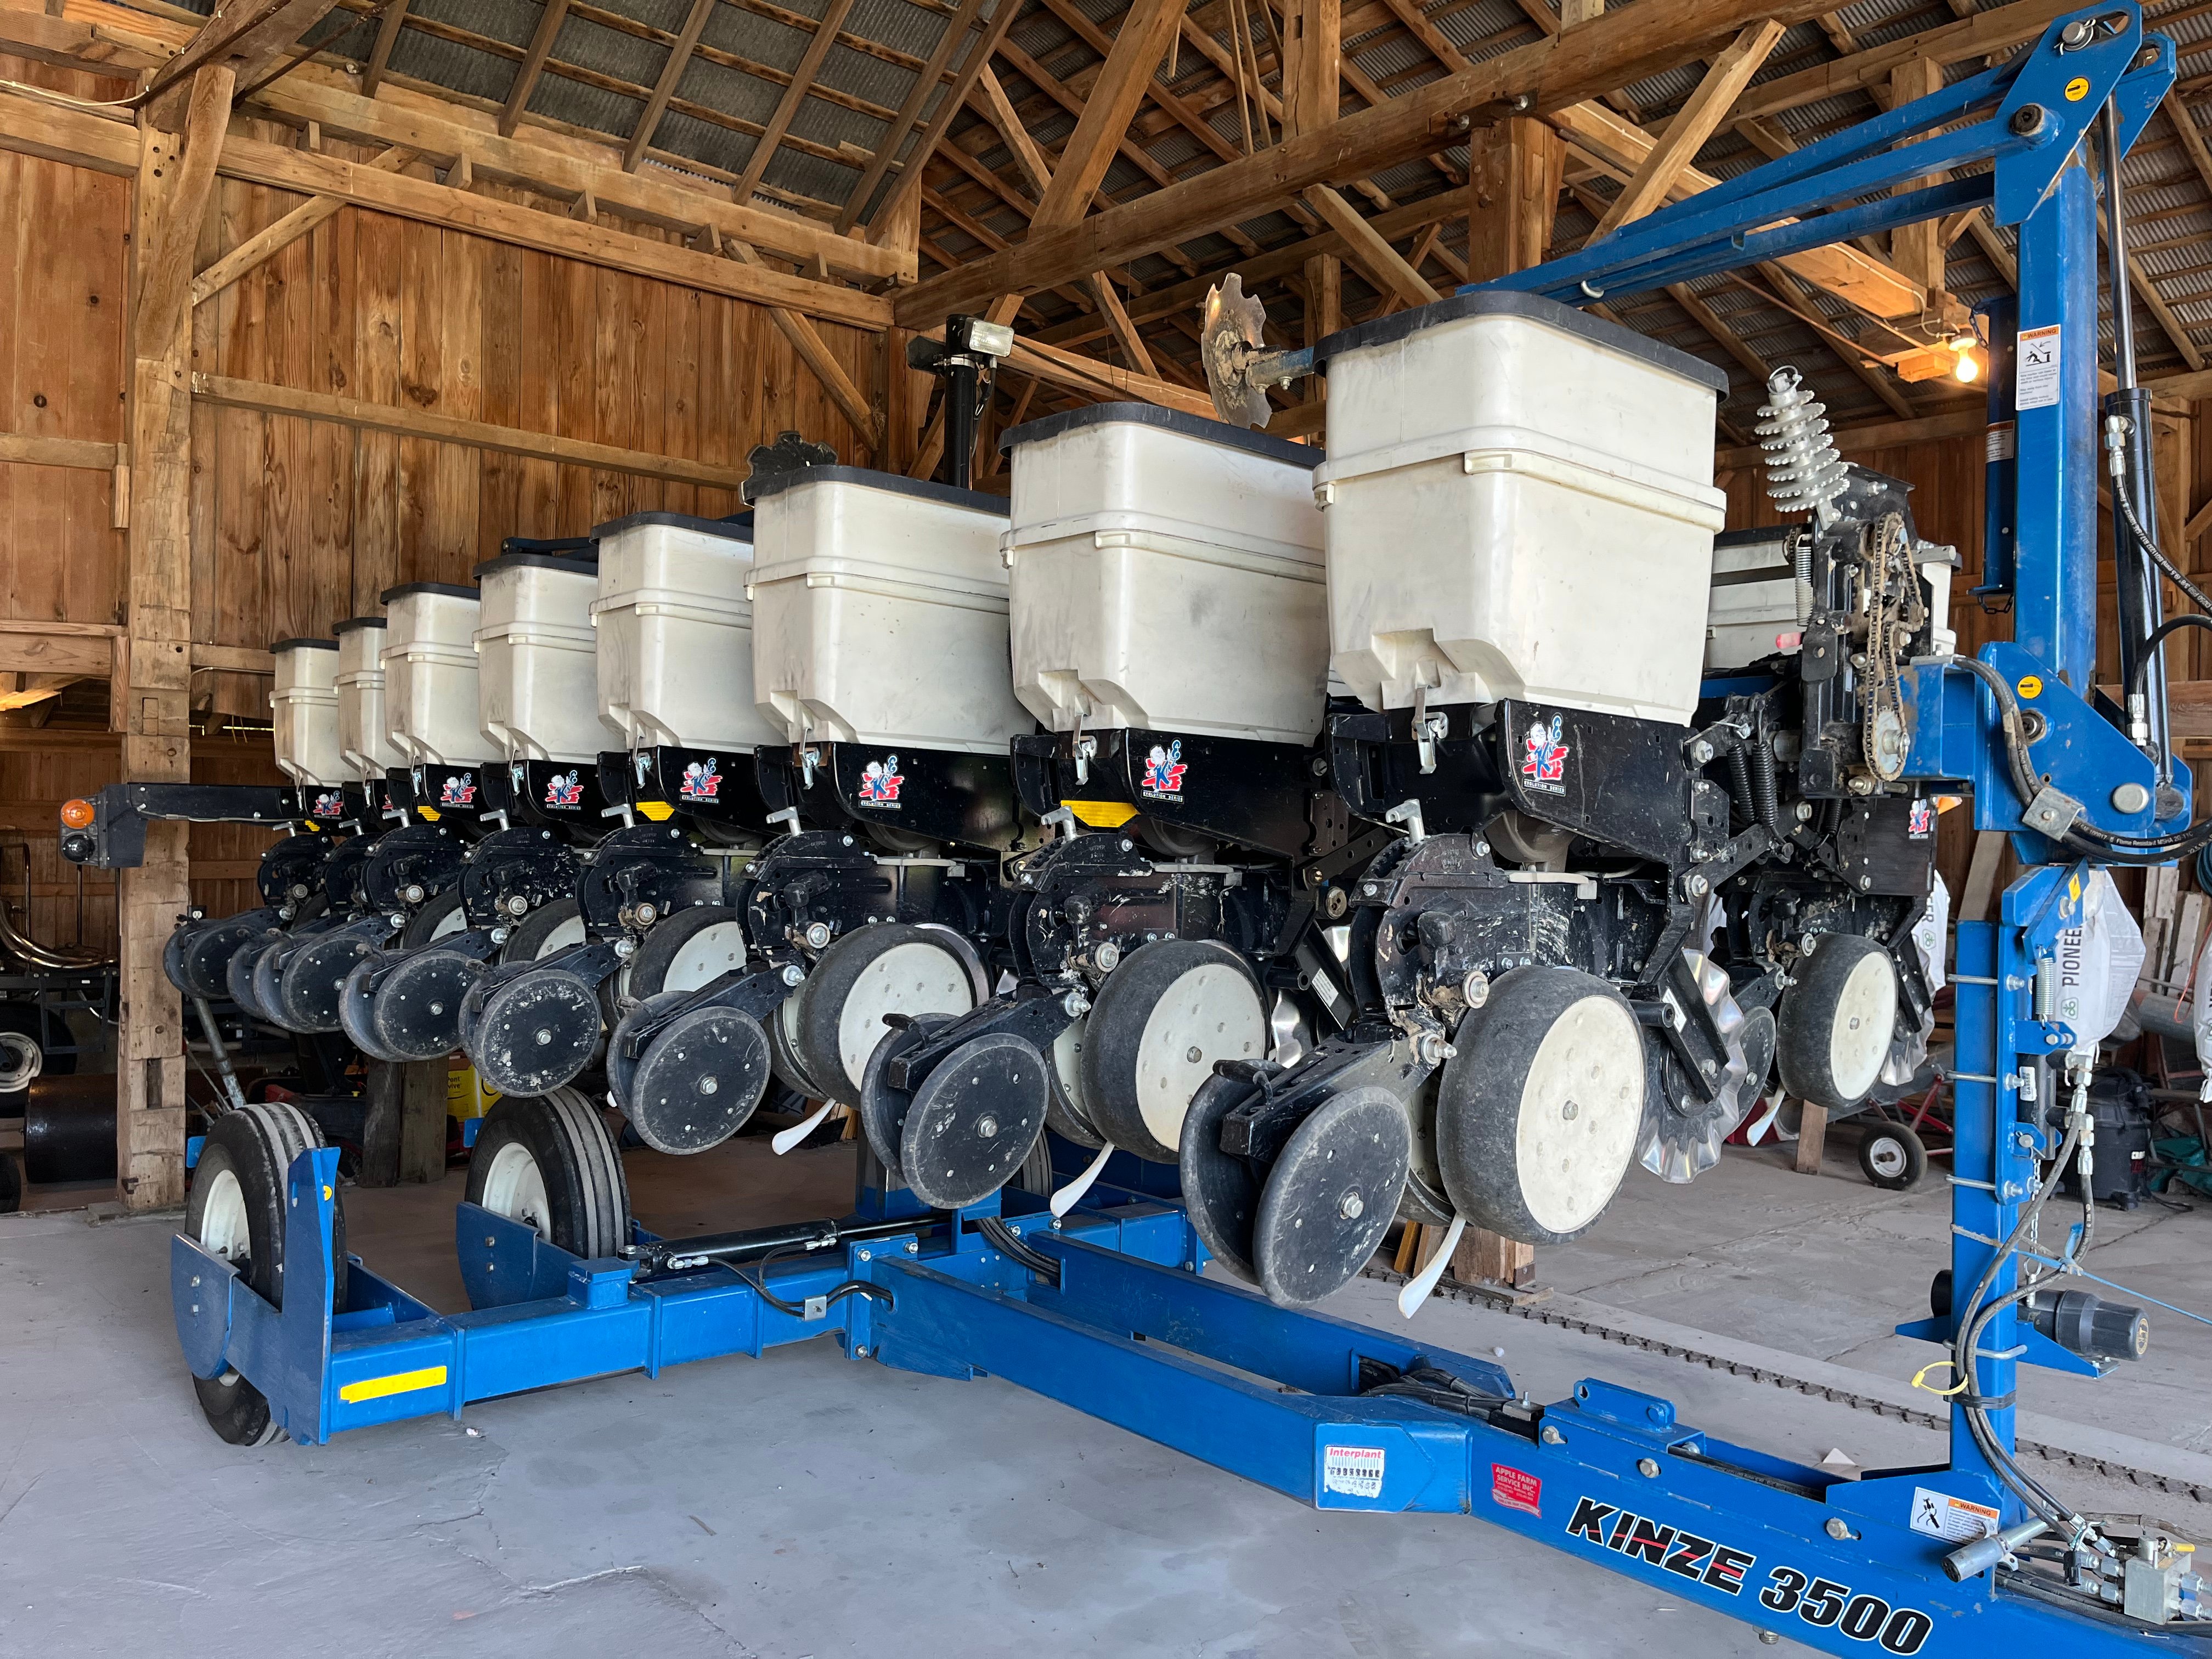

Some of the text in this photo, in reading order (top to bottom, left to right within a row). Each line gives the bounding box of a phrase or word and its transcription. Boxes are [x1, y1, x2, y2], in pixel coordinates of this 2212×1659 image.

[2028, 329, 2056, 338] WARNING
[1523, 780, 1565, 793] EVOLUTION SERIES
[2062, 926, 2083, 986] PIONEE
[1329, 1448, 1381, 1459] Interplant
[1496, 1466, 1537, 1487] APPLE FARM
[1497, 1474, 1521, 1488] SERVICE
[1960, 1502, 1991, 1516] WARNING
[1565, 1496, 1933, 1656] KINZE 3500
